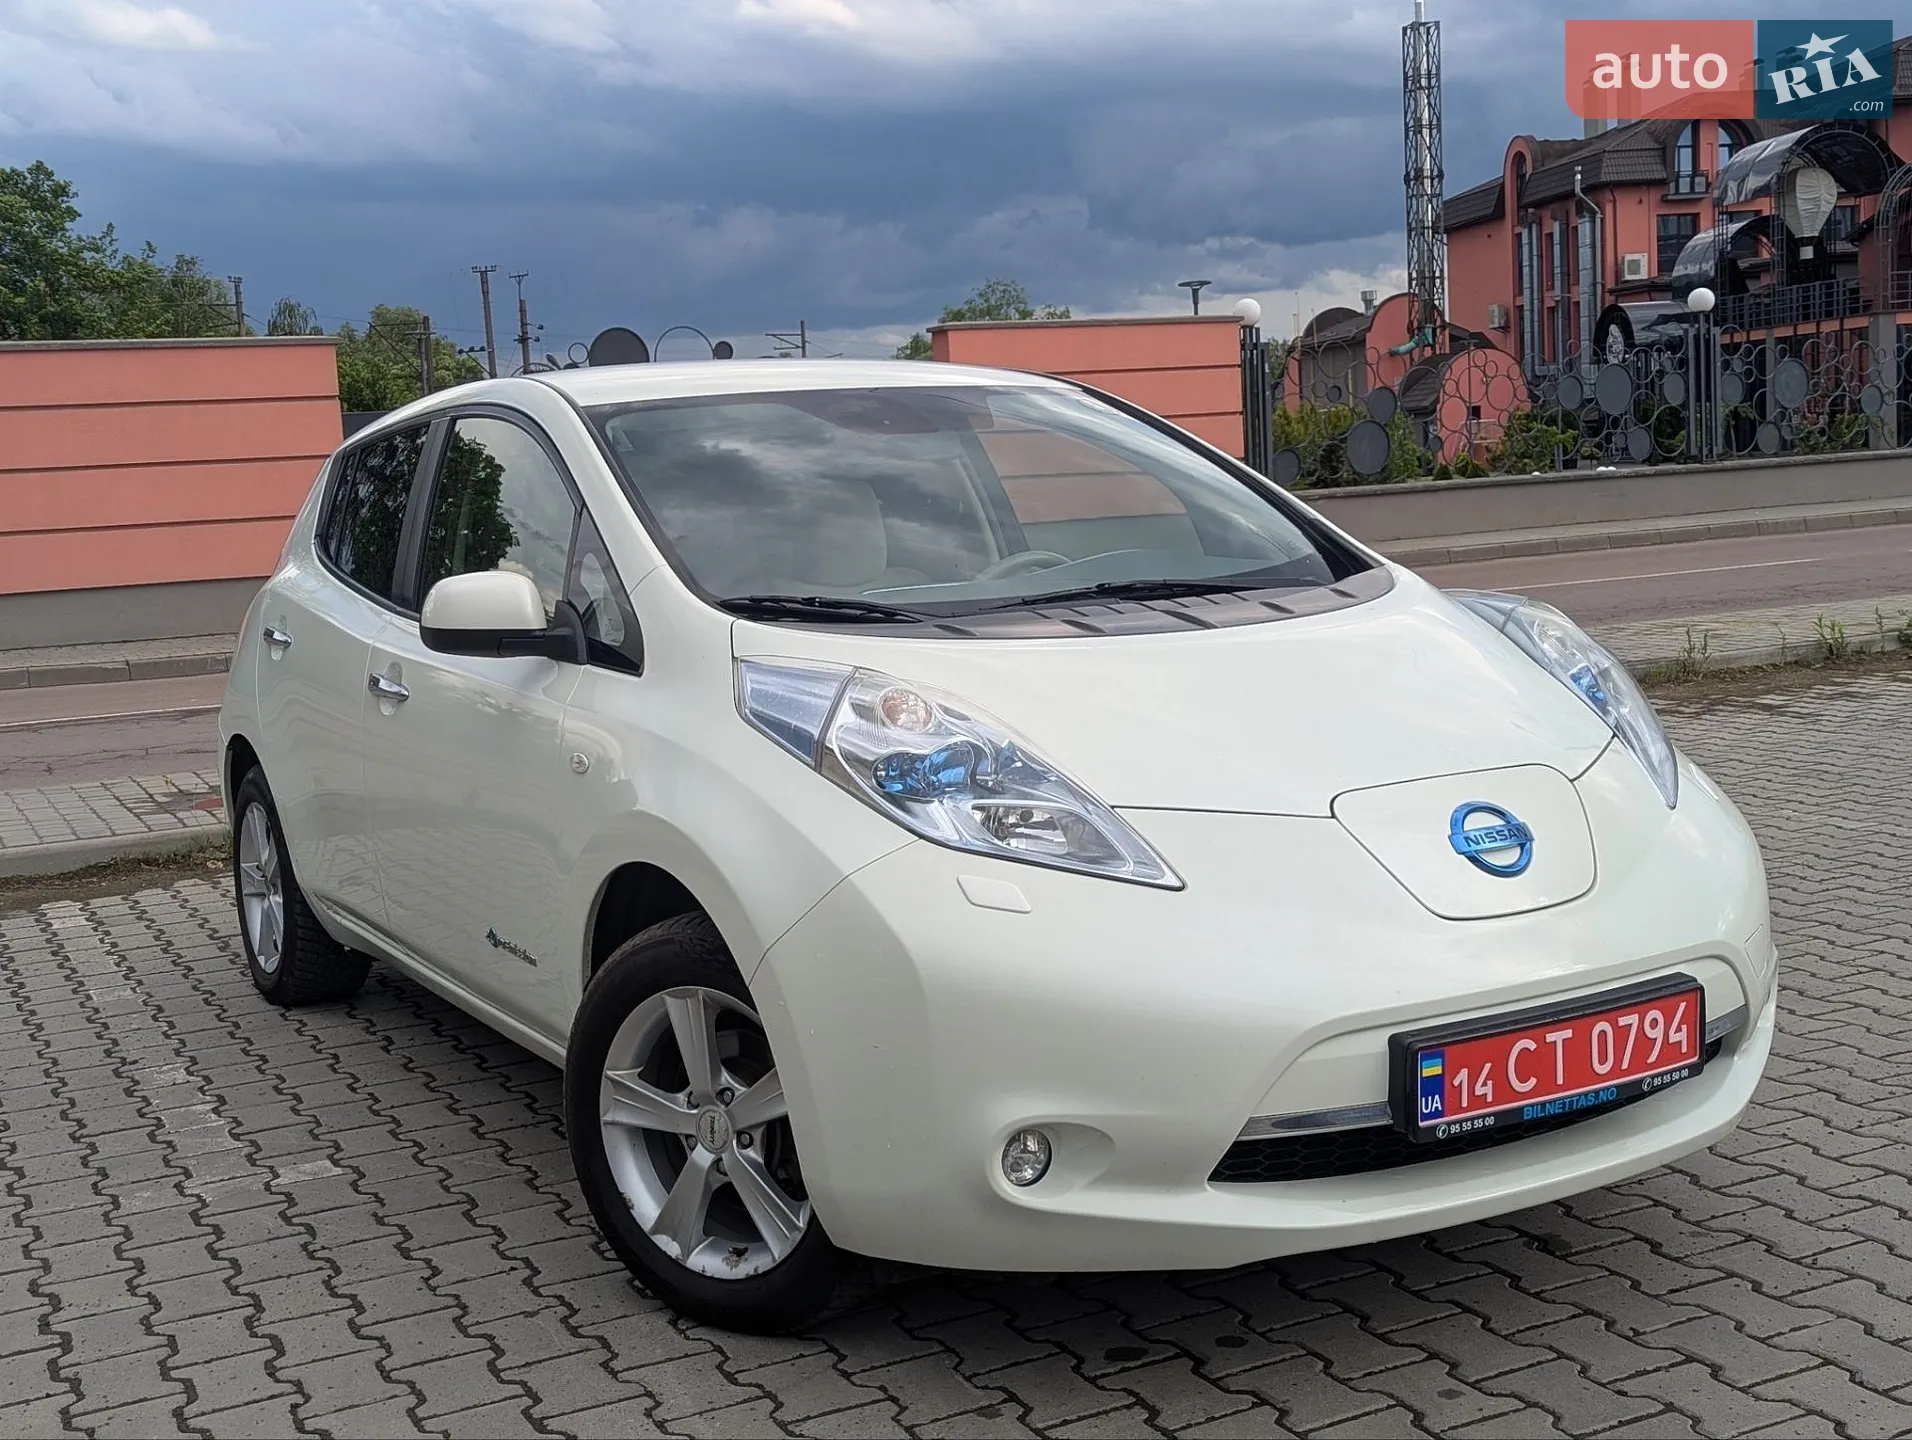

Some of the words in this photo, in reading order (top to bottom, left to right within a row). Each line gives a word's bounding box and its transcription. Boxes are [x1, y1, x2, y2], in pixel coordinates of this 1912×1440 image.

[1463, 826, 1527, 848] NISSAN
[1452, 1062, 1493, 1107] 14
[1507, 1029, 1573, 1093] CT
[1591, 1001, 1687, 1075] 0794
[1653, 1076, 1662, 1087] 95
[1421, 1094, 1442, 1113] UA
[1523, 1087, 1617, 1120] BILNETTAS.NO
[1450, 1123, 1461, 1134] 95
[1462, 1120, 1472, 1131] 55
[1473, 1118, 1484, 1129] 55
[1484, 1116, 1495, 1125] 00
